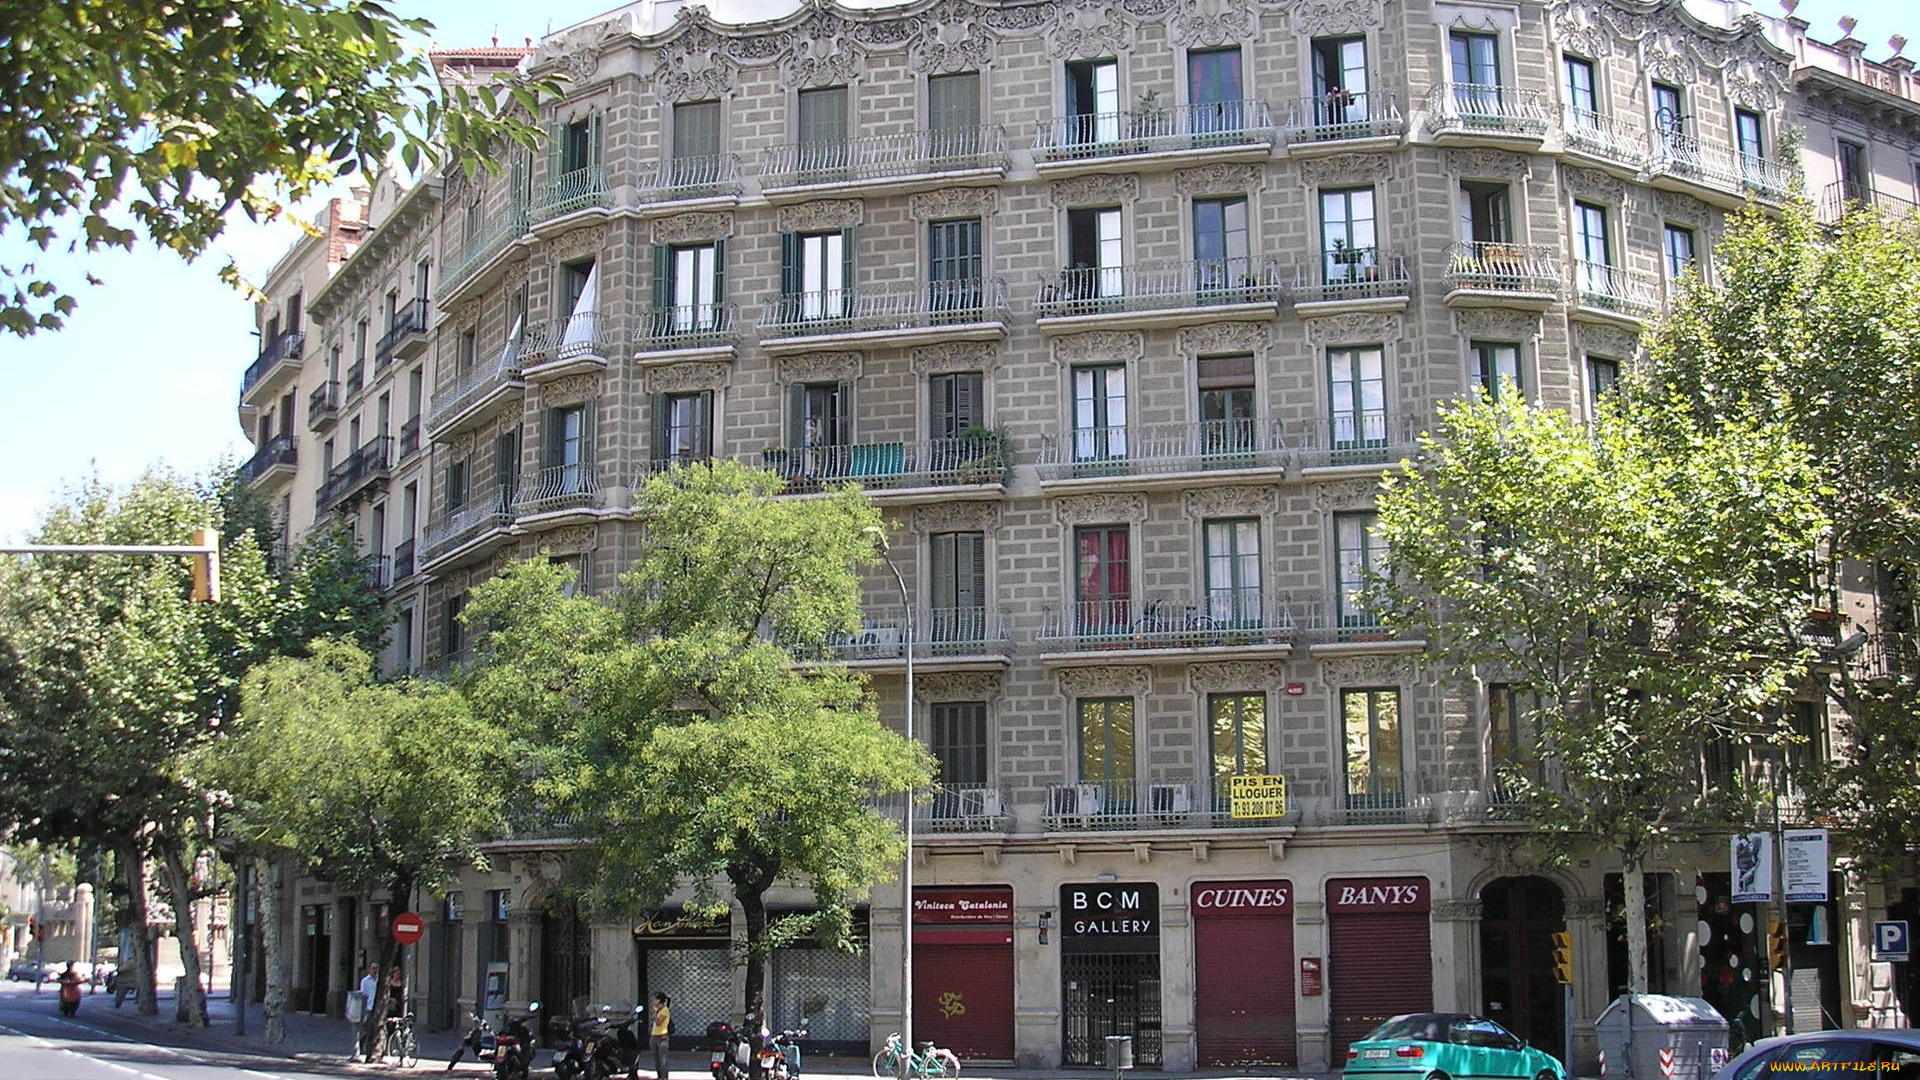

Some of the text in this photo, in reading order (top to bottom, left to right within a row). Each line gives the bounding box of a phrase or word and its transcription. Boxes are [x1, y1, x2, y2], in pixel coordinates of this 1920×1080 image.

[1233, 777, 1283, 786] PIS EN
[1233, 788, 1283, 799] LLOGUER
[1197, 888, 1288, 908] CUINES
[1337, 885, 1419, 905] BANYS
[914, 899, 956, 910] Viniteca
[1074, 920, 1151, 934] GALLERY
[1880, 925, 1902, 950] P
